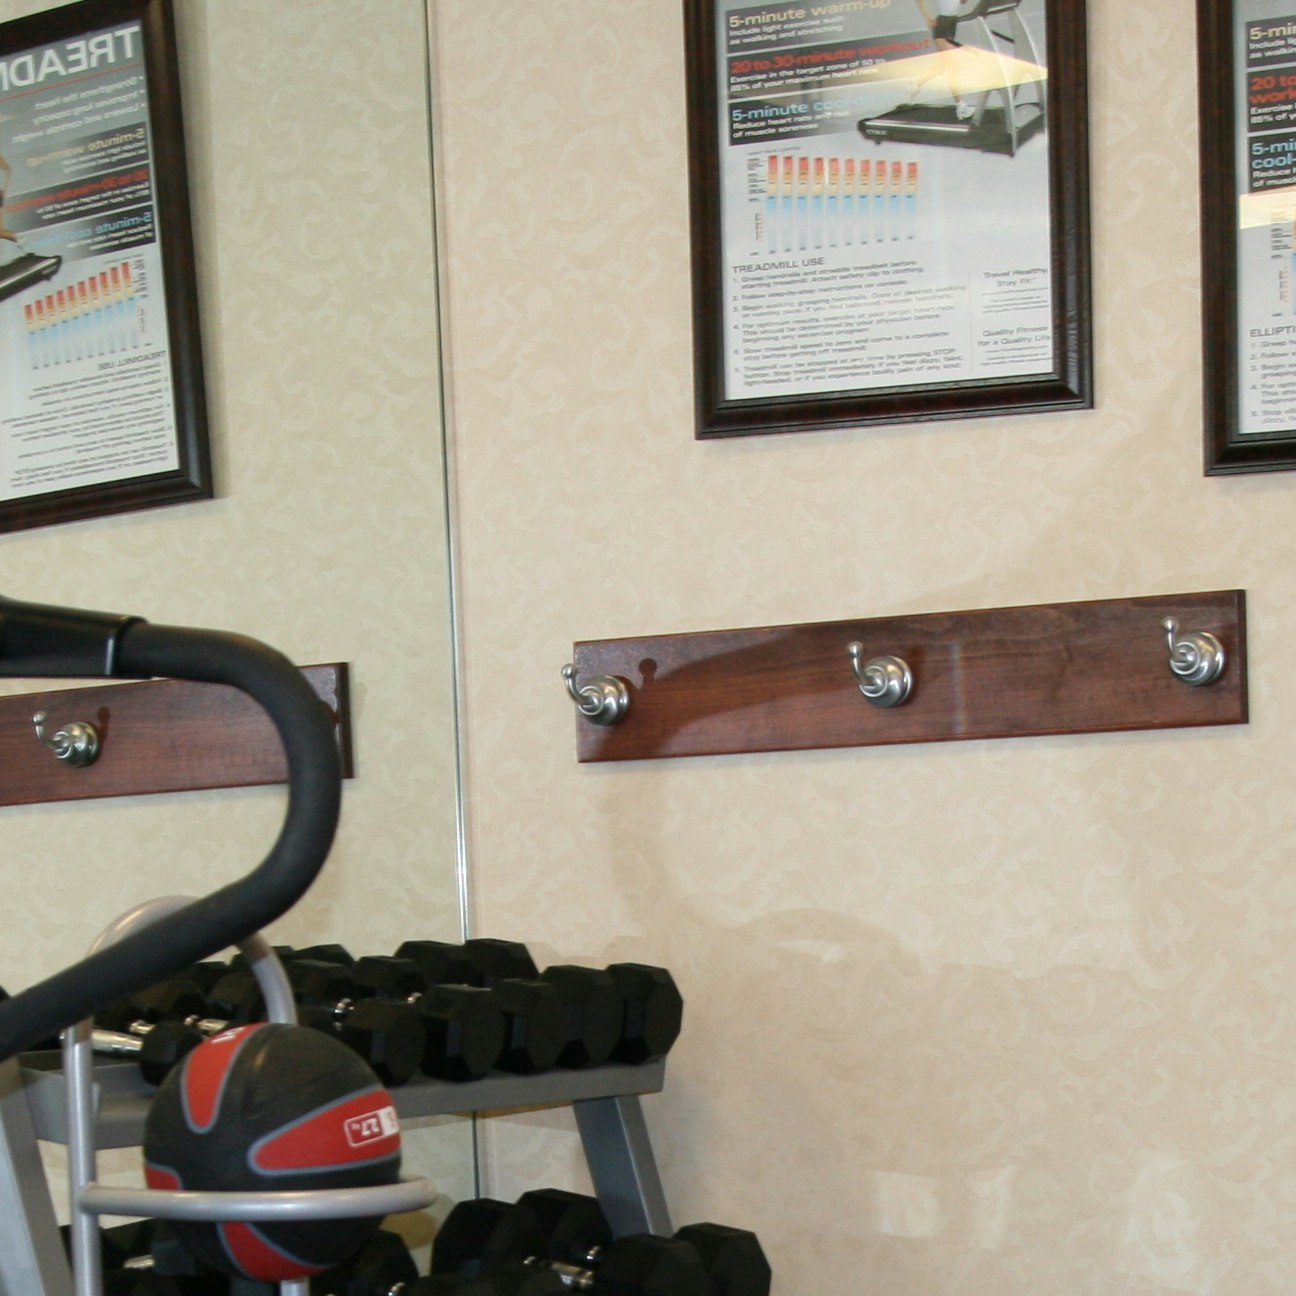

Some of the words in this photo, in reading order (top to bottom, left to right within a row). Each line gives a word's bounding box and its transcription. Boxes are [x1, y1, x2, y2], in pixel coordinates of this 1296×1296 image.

[730, 10, 804, 27] 5-minute
[1251, 76, 1276, 90] 20
[732, 104, 807, 121] 5-minute
[733, 261, 797, 272] TREADMILL
[802, 257, 824, 267] USE
